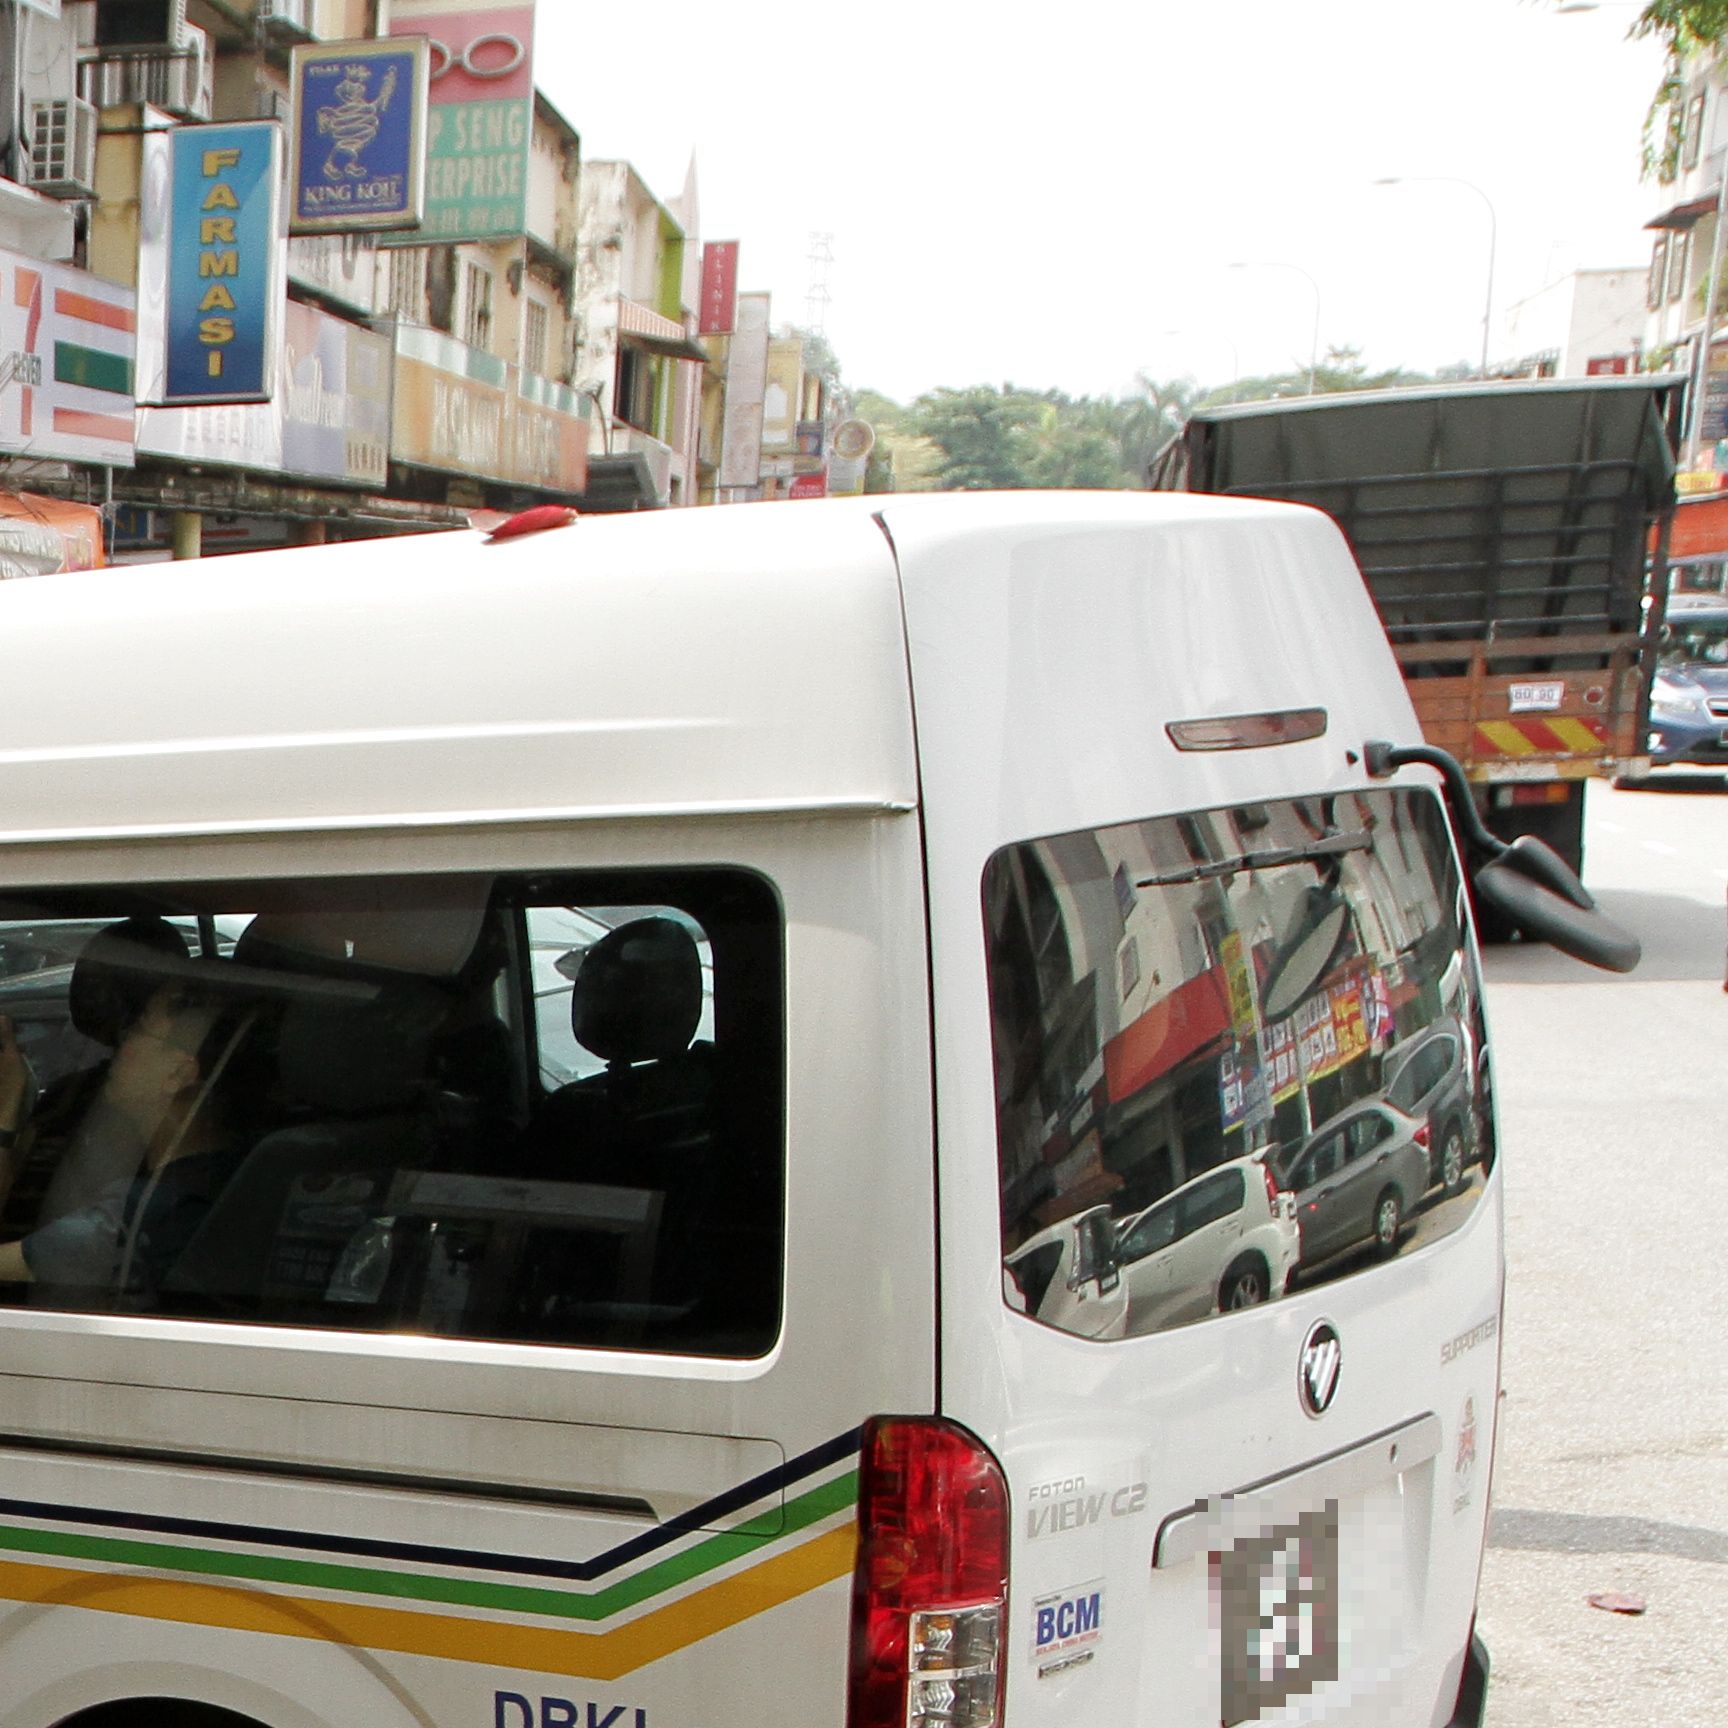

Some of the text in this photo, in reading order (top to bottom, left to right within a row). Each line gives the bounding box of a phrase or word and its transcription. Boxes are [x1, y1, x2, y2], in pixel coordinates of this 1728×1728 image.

[455, 104, 524, 152] SENG
[304, 184, 352, 205] KING
[198, 148, 241, 378] FARMASI
[1027, 1483, 1149, 1540] VIEW C2
[1028, 1476, 1085, 1499] FOTON
[1036, 1592, 1100, 1646] BCM
